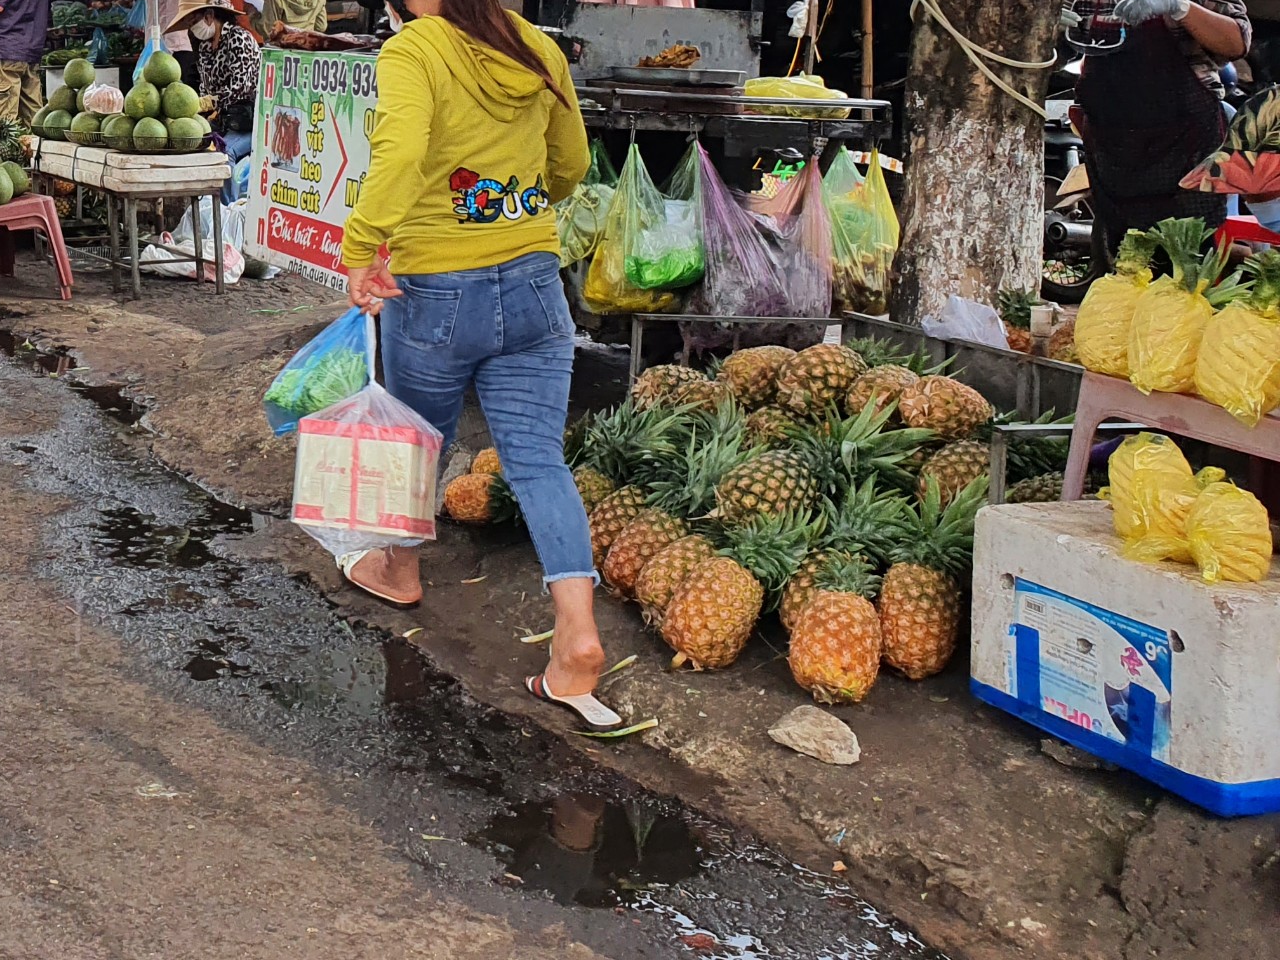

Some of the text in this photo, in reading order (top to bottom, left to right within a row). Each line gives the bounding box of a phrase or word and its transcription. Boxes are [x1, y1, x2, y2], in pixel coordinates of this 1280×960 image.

[312, 58, 347, 94] 0934
[300, 154, 322, 183] heo
[271, 179, 298, 208] chim
